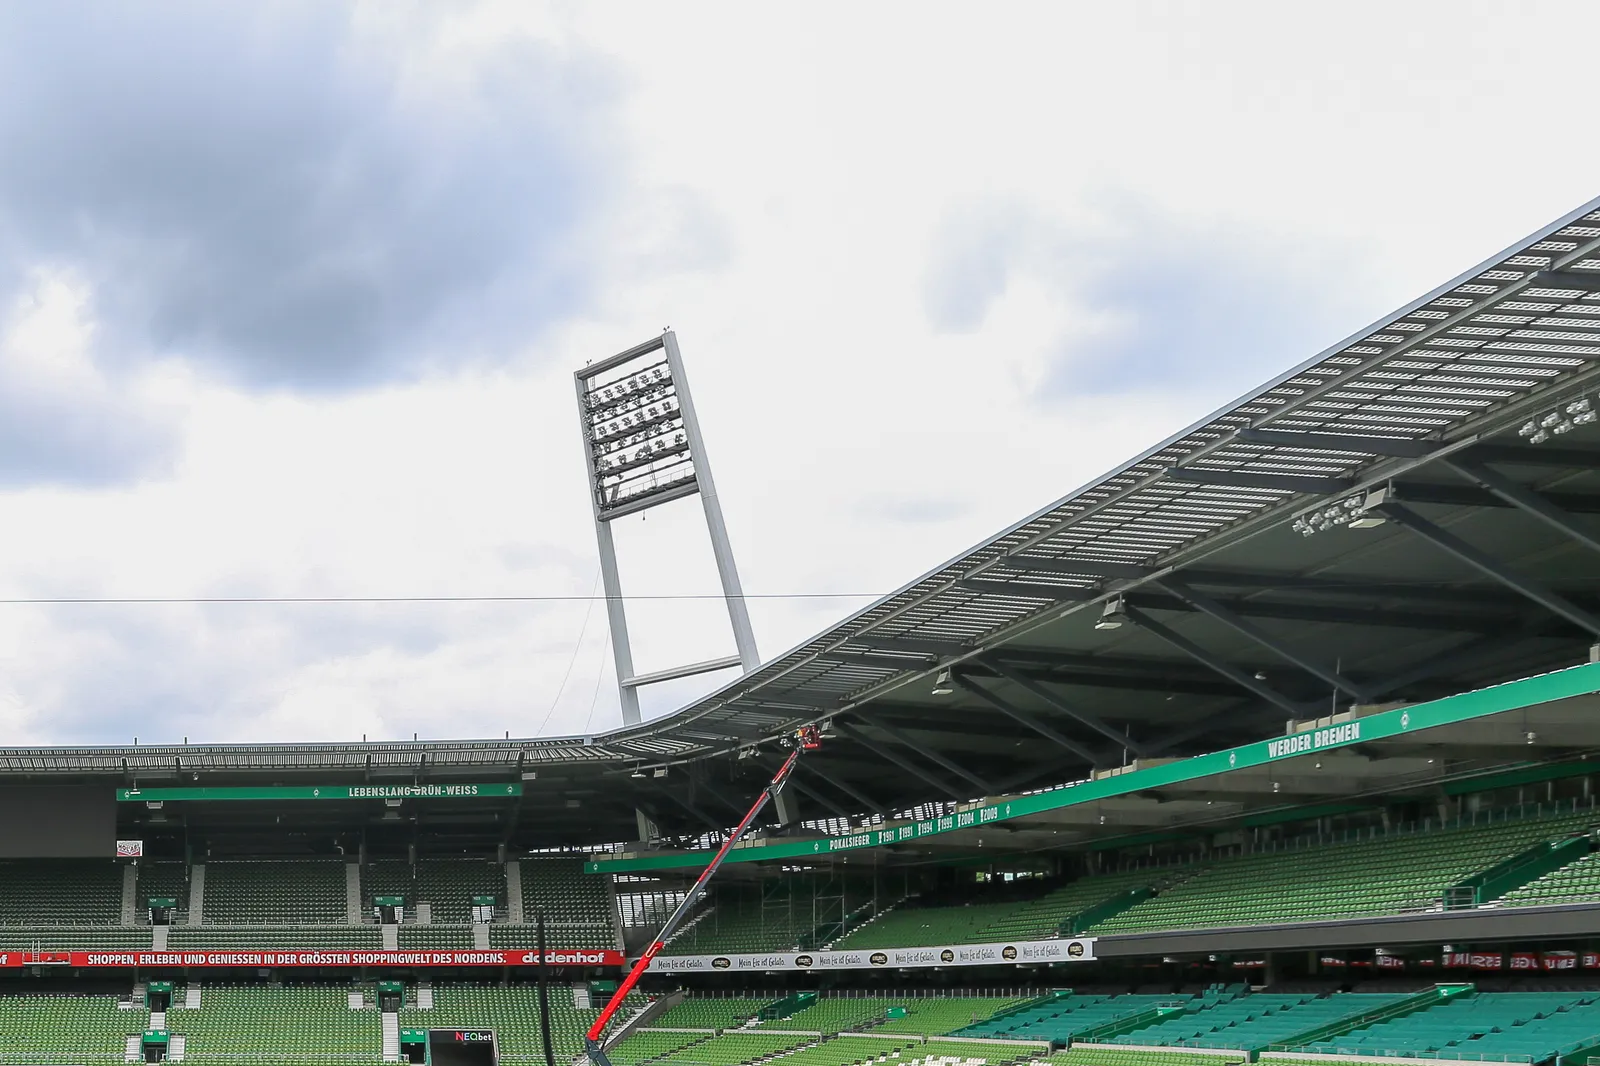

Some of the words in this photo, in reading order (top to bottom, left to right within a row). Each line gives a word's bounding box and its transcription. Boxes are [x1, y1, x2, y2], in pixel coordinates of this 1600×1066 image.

[1268, 734, 1311, 758] WERDER
[1314, 722, 1360, 748] BREMEN
[349, 787, 412, 797] LEBENSLANG
[830, 834, 870, 850] POKALSIEGER
[87, 954, 138, 966] SHOPPEN,
[139, 954, 182, 965] ERLEBEN
[184, 954, 206, 965] UND
[208, 954, 262, 965] GENIESSEN
[264, 954, 275, 964] IN
[277, 953, 297, 964] DER
[299, 951, 350, 964] GRÖSSTEN
[352, 953, 431, 964] SHOPPINGWELT
[432, 953, 452, 964] DES
[454, 953, 507, 964] NORDENS.
